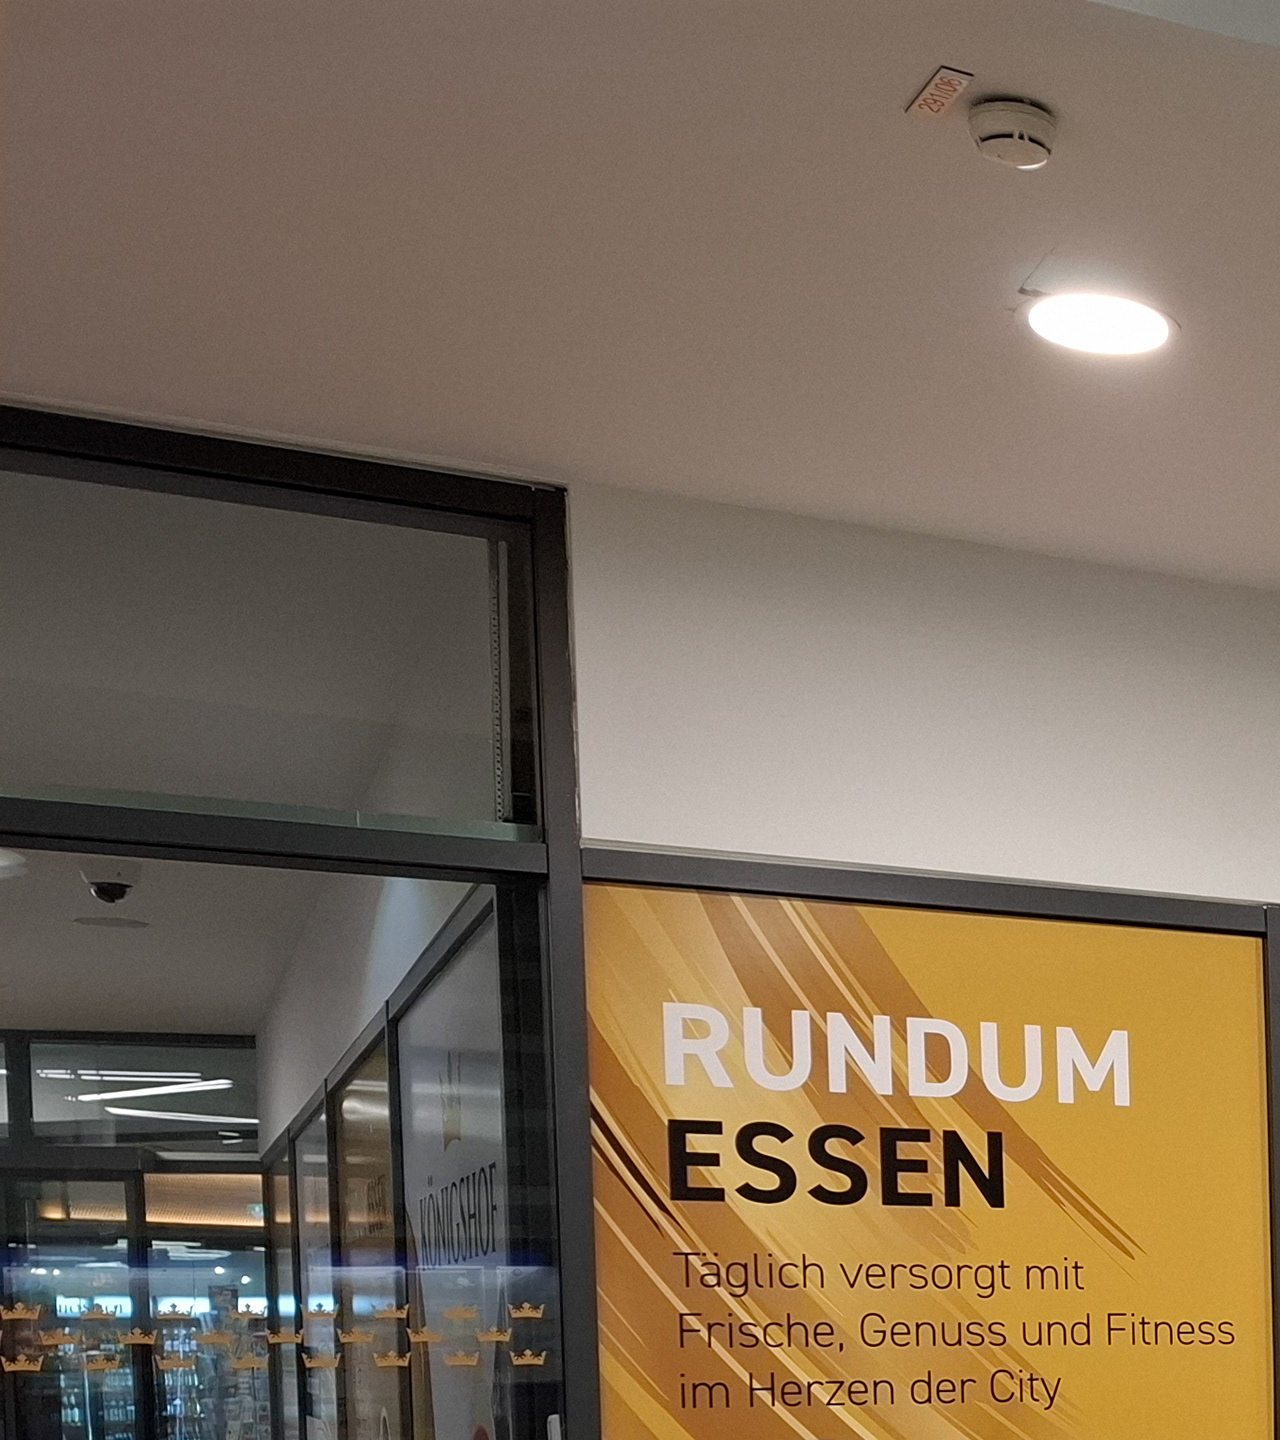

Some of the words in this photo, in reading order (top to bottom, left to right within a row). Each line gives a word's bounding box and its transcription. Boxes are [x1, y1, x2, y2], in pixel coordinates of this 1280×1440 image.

[662, 1001, 1131, 1107] RUNDUM
[666, 1118, 1006, 1209] ESSEN
[672, 1252, 825, 1297] Täglich
[840, 1258, 1011, 1299] versorgt
[1025, 1256, 1085, 1291] mit
[677, 1312, 845, 1353] Frische,
[860, 1313, 1007, 1348] Genuss
[1021, 1312, 1092, 1346] und
[1106, 1312, 1236, 1345] Fitness
[679, 1373, 731, 1409] im
[747, 1373, 895, 1407] Herzen
[909, 1370, 977, 1405] der
[989, 1368, 1062, 1410] City
